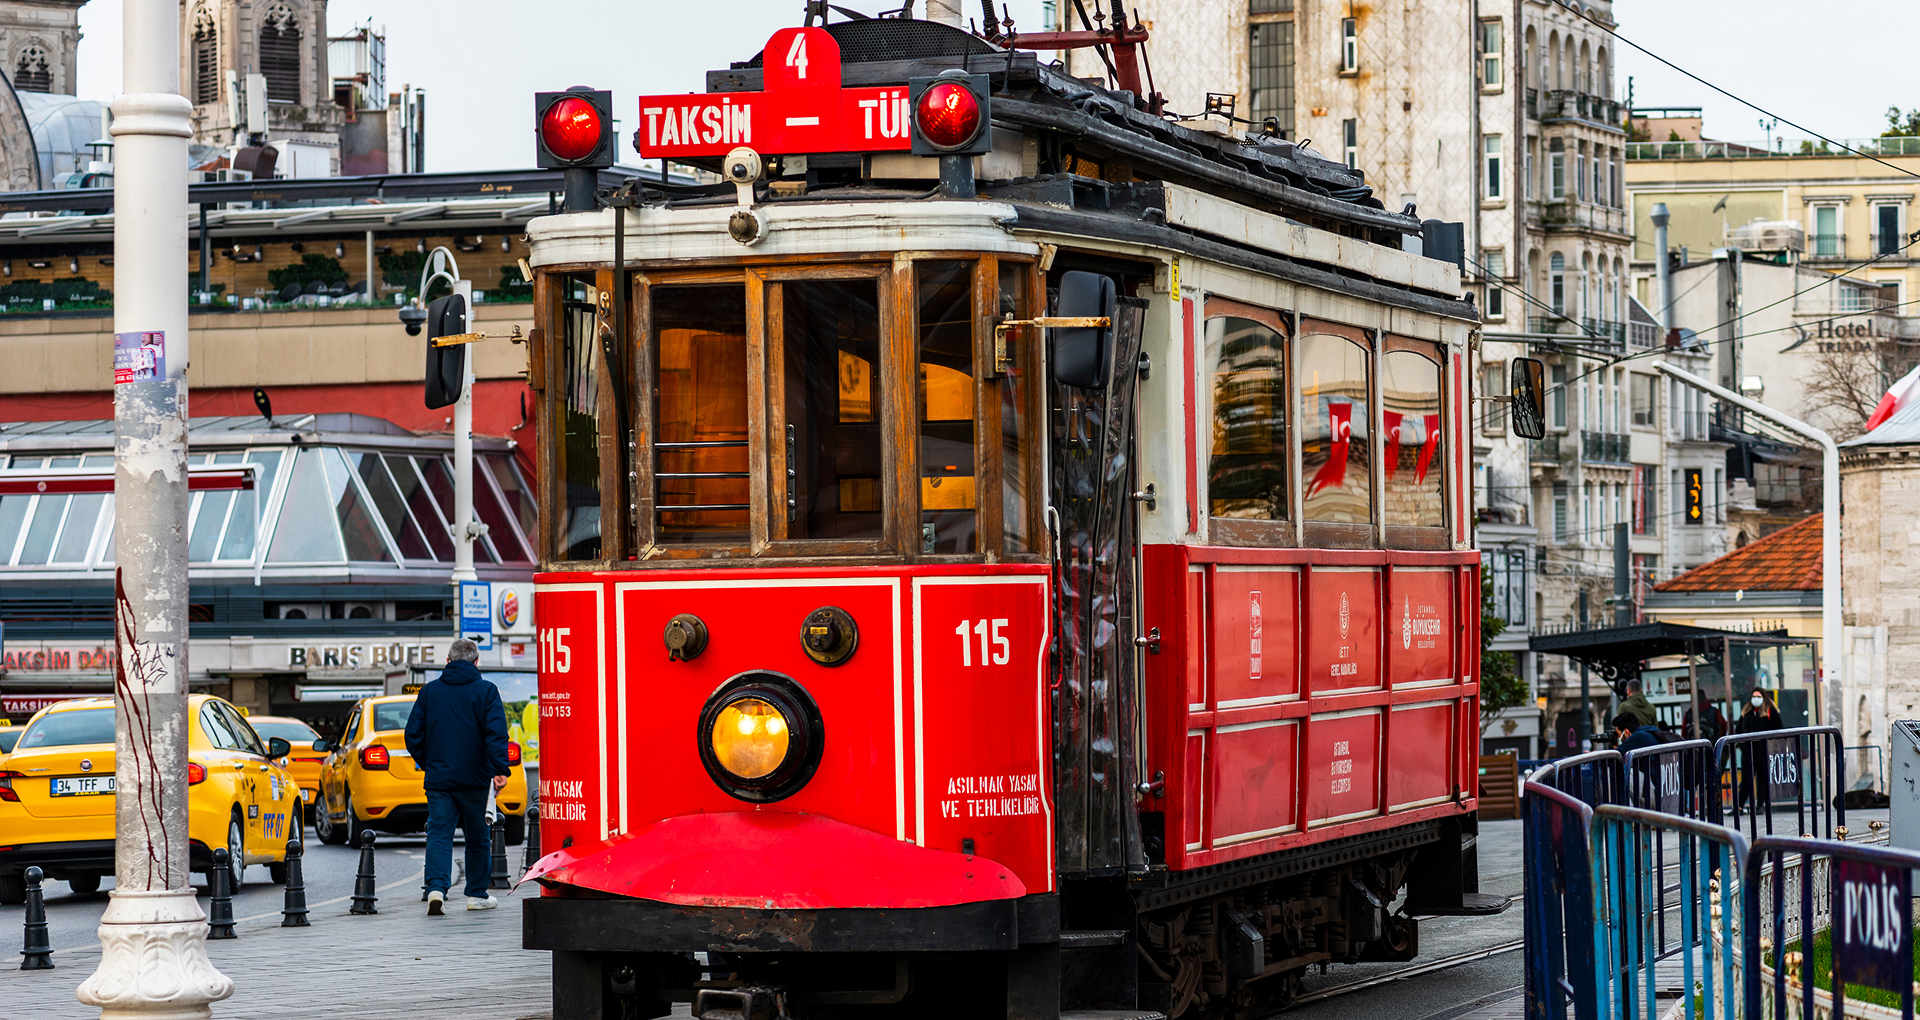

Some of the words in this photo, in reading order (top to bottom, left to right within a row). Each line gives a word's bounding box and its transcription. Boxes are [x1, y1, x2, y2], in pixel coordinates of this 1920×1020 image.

[786, 33, 808, 79] 4
[644, 97, 751, 146] TAKSİM
[1818, 319, 1872, 338] Hotel
[1412, 613, 1441, 640] BÜYÜKŞEHİR
[540, 628, 571, 673] 115
[955, 618, 1010, 667] 115
[2, 647, 71, 669] AKSİM
[289, 644, 362, 669] BARIŞ
[371, 643, 435, 666] BÜFE
[541, 705, 554, 717] ALO
[555, 705, 571, 717] 153
[1660, 754, 1681, 798] POLİS
[1768, 745, 1797, 786] POLİS
[58, 780, 71, 792] 34
[78, 778, 98, 791] TFF
[108, 777, 116, 790] 0
[553, 780, 583, 798] YASAK
[947, 775, 1004, 795] ASILMAK
[1008, 773, 1037, 793] YASAK
[941, 800, 960, 818] VE
[966, 794, 1040, 817] TEHLİKELİDİR
[263, 813, 276, 839] TFF
[275, 813, 286, 839] 07
[1843, 869, 1902, 955] POLİS
